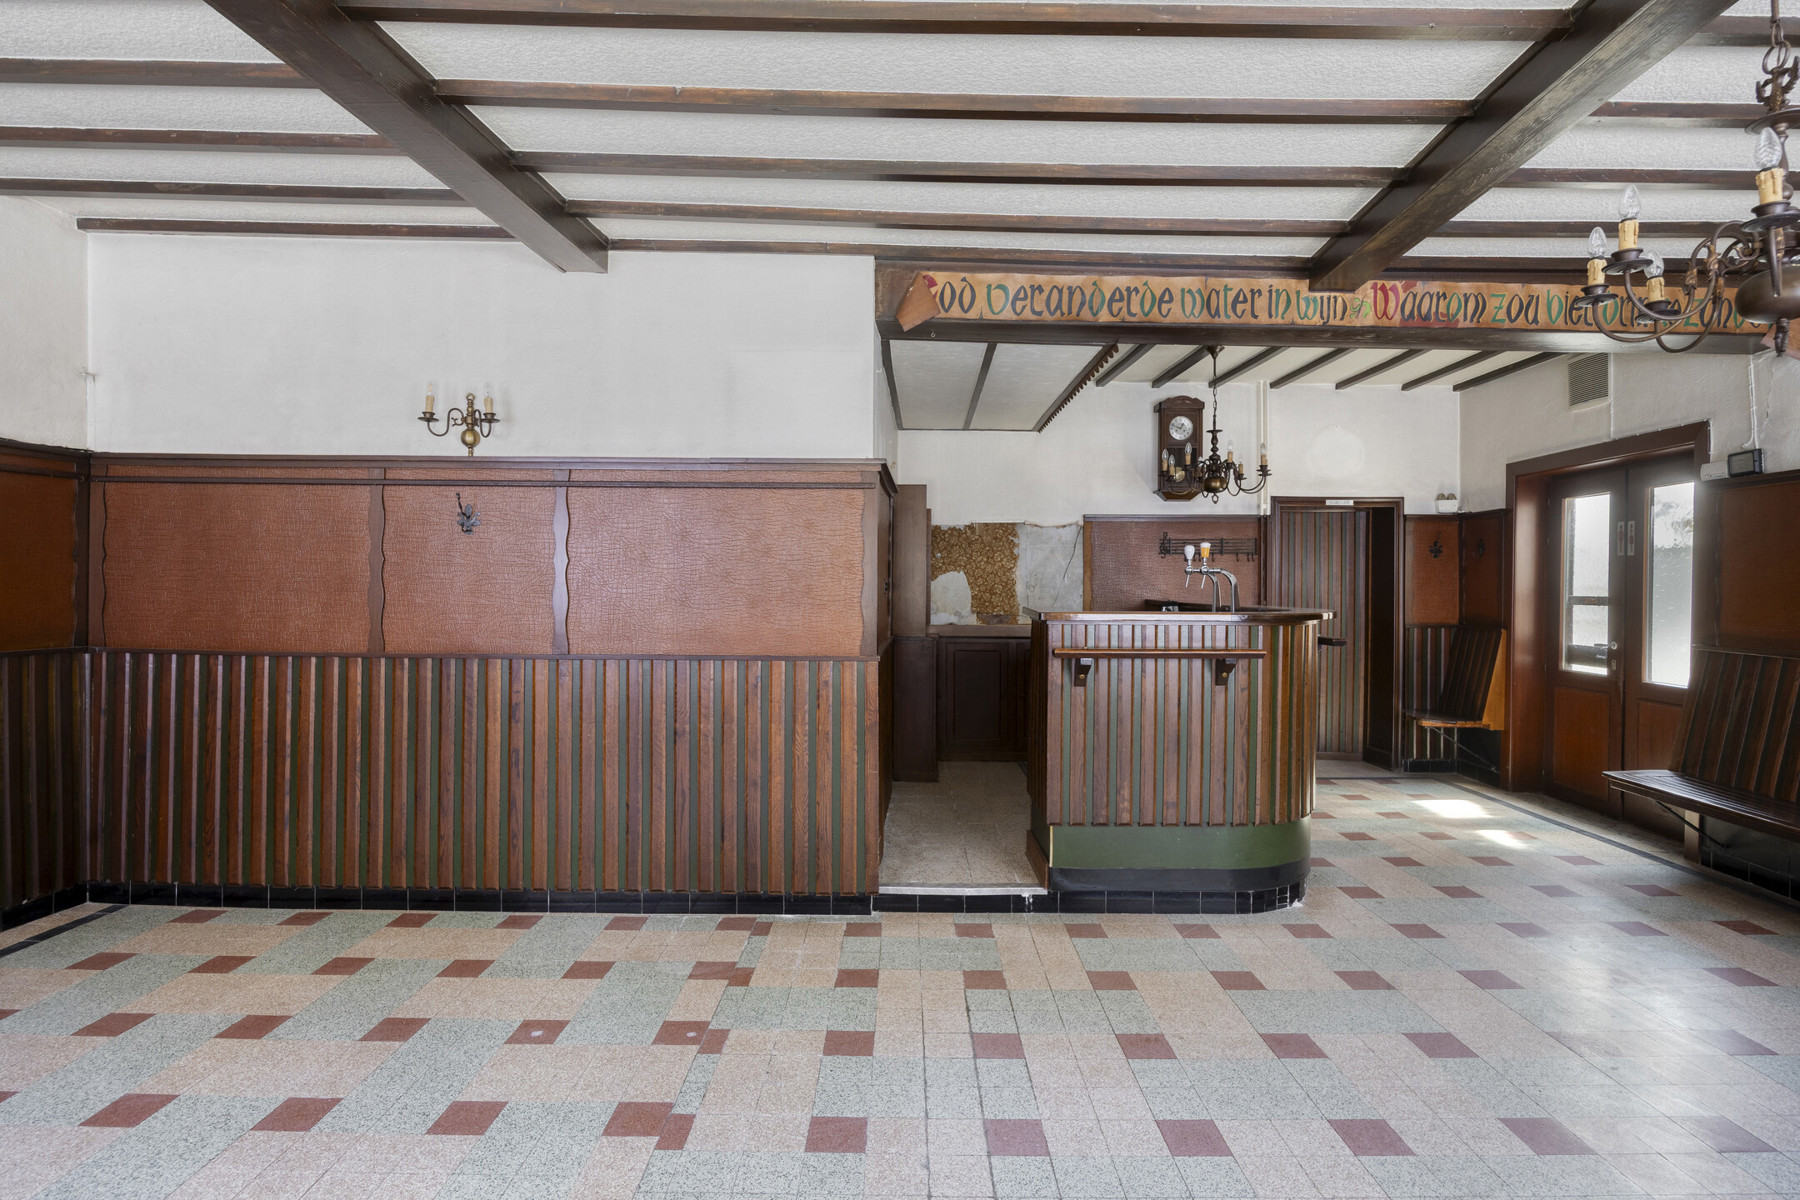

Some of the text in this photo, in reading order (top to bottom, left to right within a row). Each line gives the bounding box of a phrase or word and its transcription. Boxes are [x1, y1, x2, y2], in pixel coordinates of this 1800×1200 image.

[923, 274, 977, 314] od
[1180, 284, 1262, 320] water
[1267, 284, 1292, 320] in
[1370, 281, 1487, 324] Waarom
[1490, 291, 1540, 326] zou
